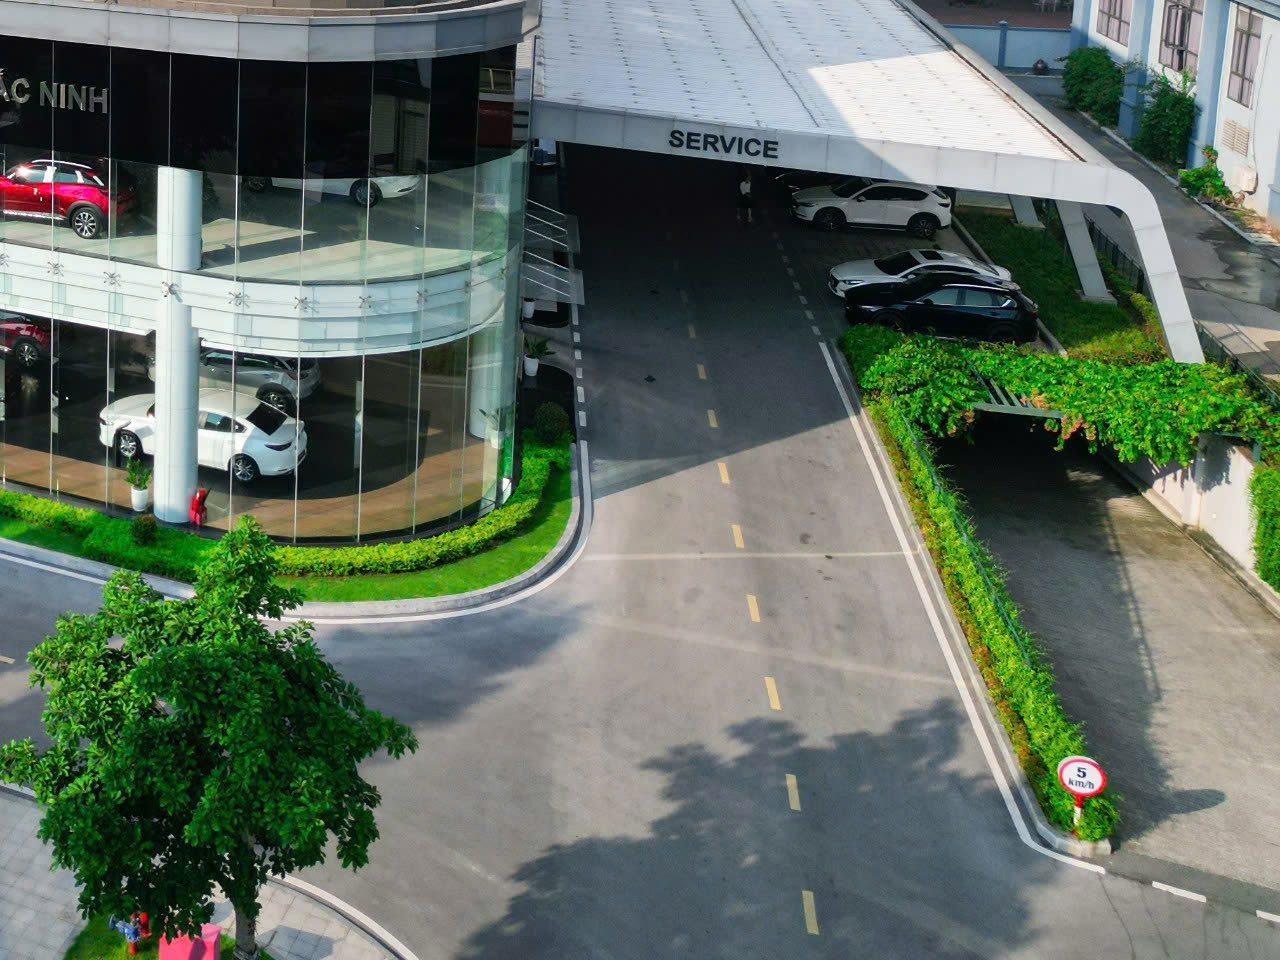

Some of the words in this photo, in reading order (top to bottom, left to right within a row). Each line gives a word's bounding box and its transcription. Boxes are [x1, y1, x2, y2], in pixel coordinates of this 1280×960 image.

[39, 81, 109, 114] NINH
[669, 129, 779, 159] SERVICE
[1076, 767, 1087, 778] 5
[1068, 778, 1095, 789] km/h
